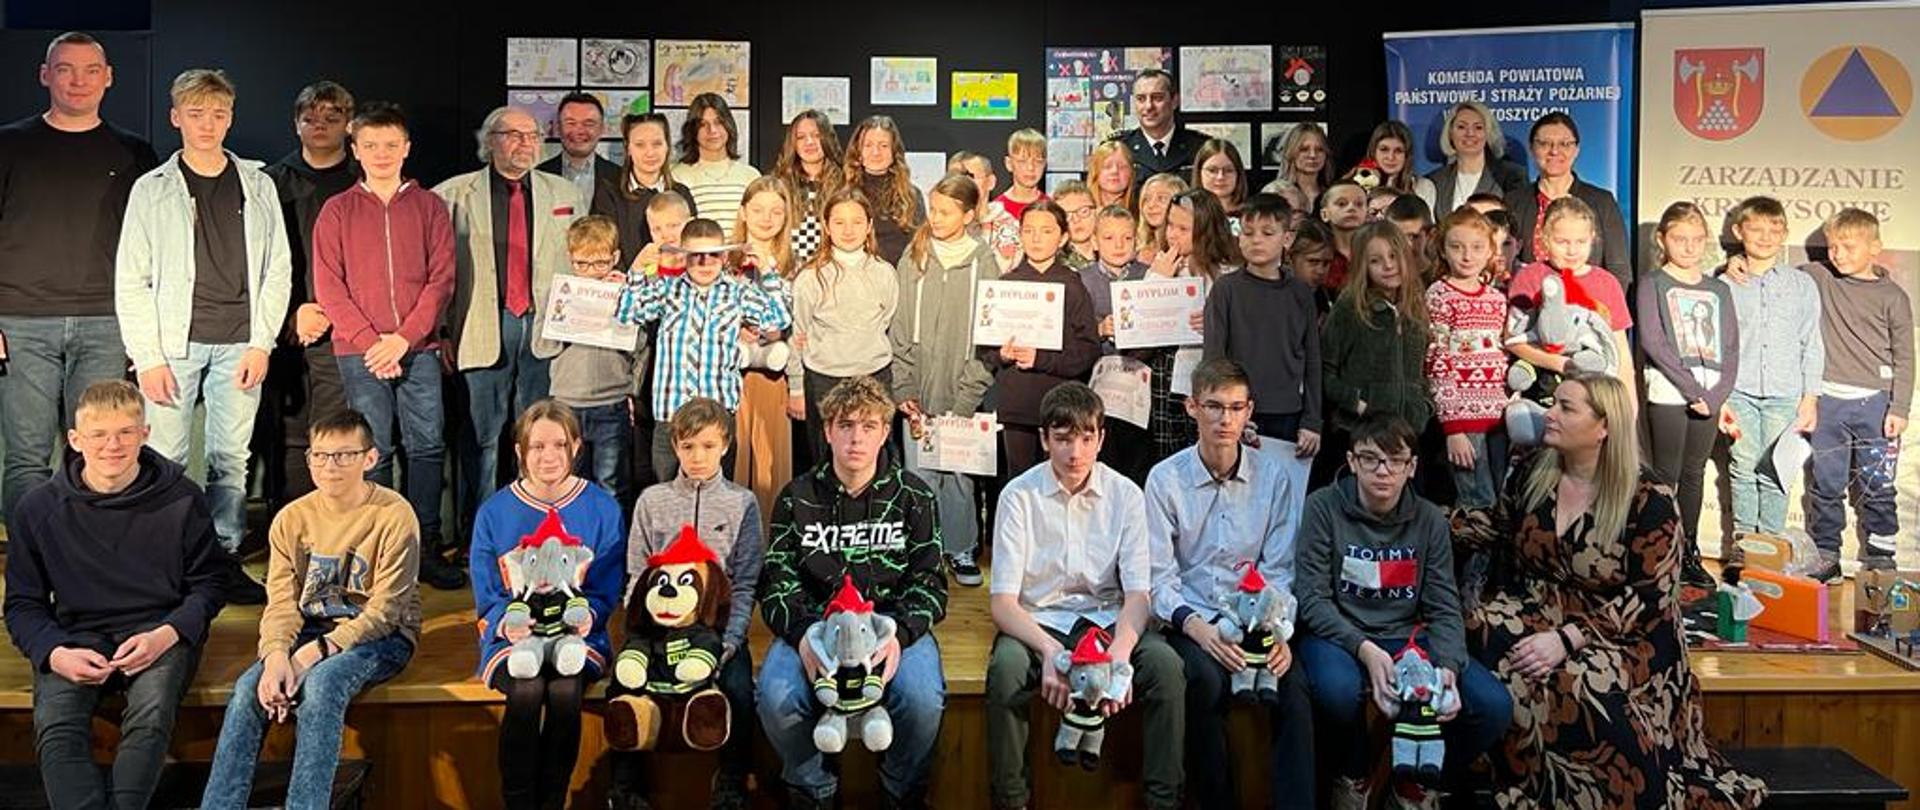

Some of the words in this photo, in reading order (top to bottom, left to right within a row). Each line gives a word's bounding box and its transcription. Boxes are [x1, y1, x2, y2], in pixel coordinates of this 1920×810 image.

[1428, 71, 1494, 85] KOMENDA
[1499, 67, 1584, 82] POWIATOWA
[1395, 90, 1486, 105] PAŃSTWOWEJ
[1490, 85, 1544, 103] STRAŻY
[1549, 85, 1622, 101] POŻARNEJ
[1679, 165, 1904, 192] ZARZĄDZANIE
[999, 289, 1039, 301] DYPLOM
[1136, 286, 1179, 298] DYPLOM
[801, 521, 906, 553] EXTREME
[1341, 580, 1415, 600] JEANS
